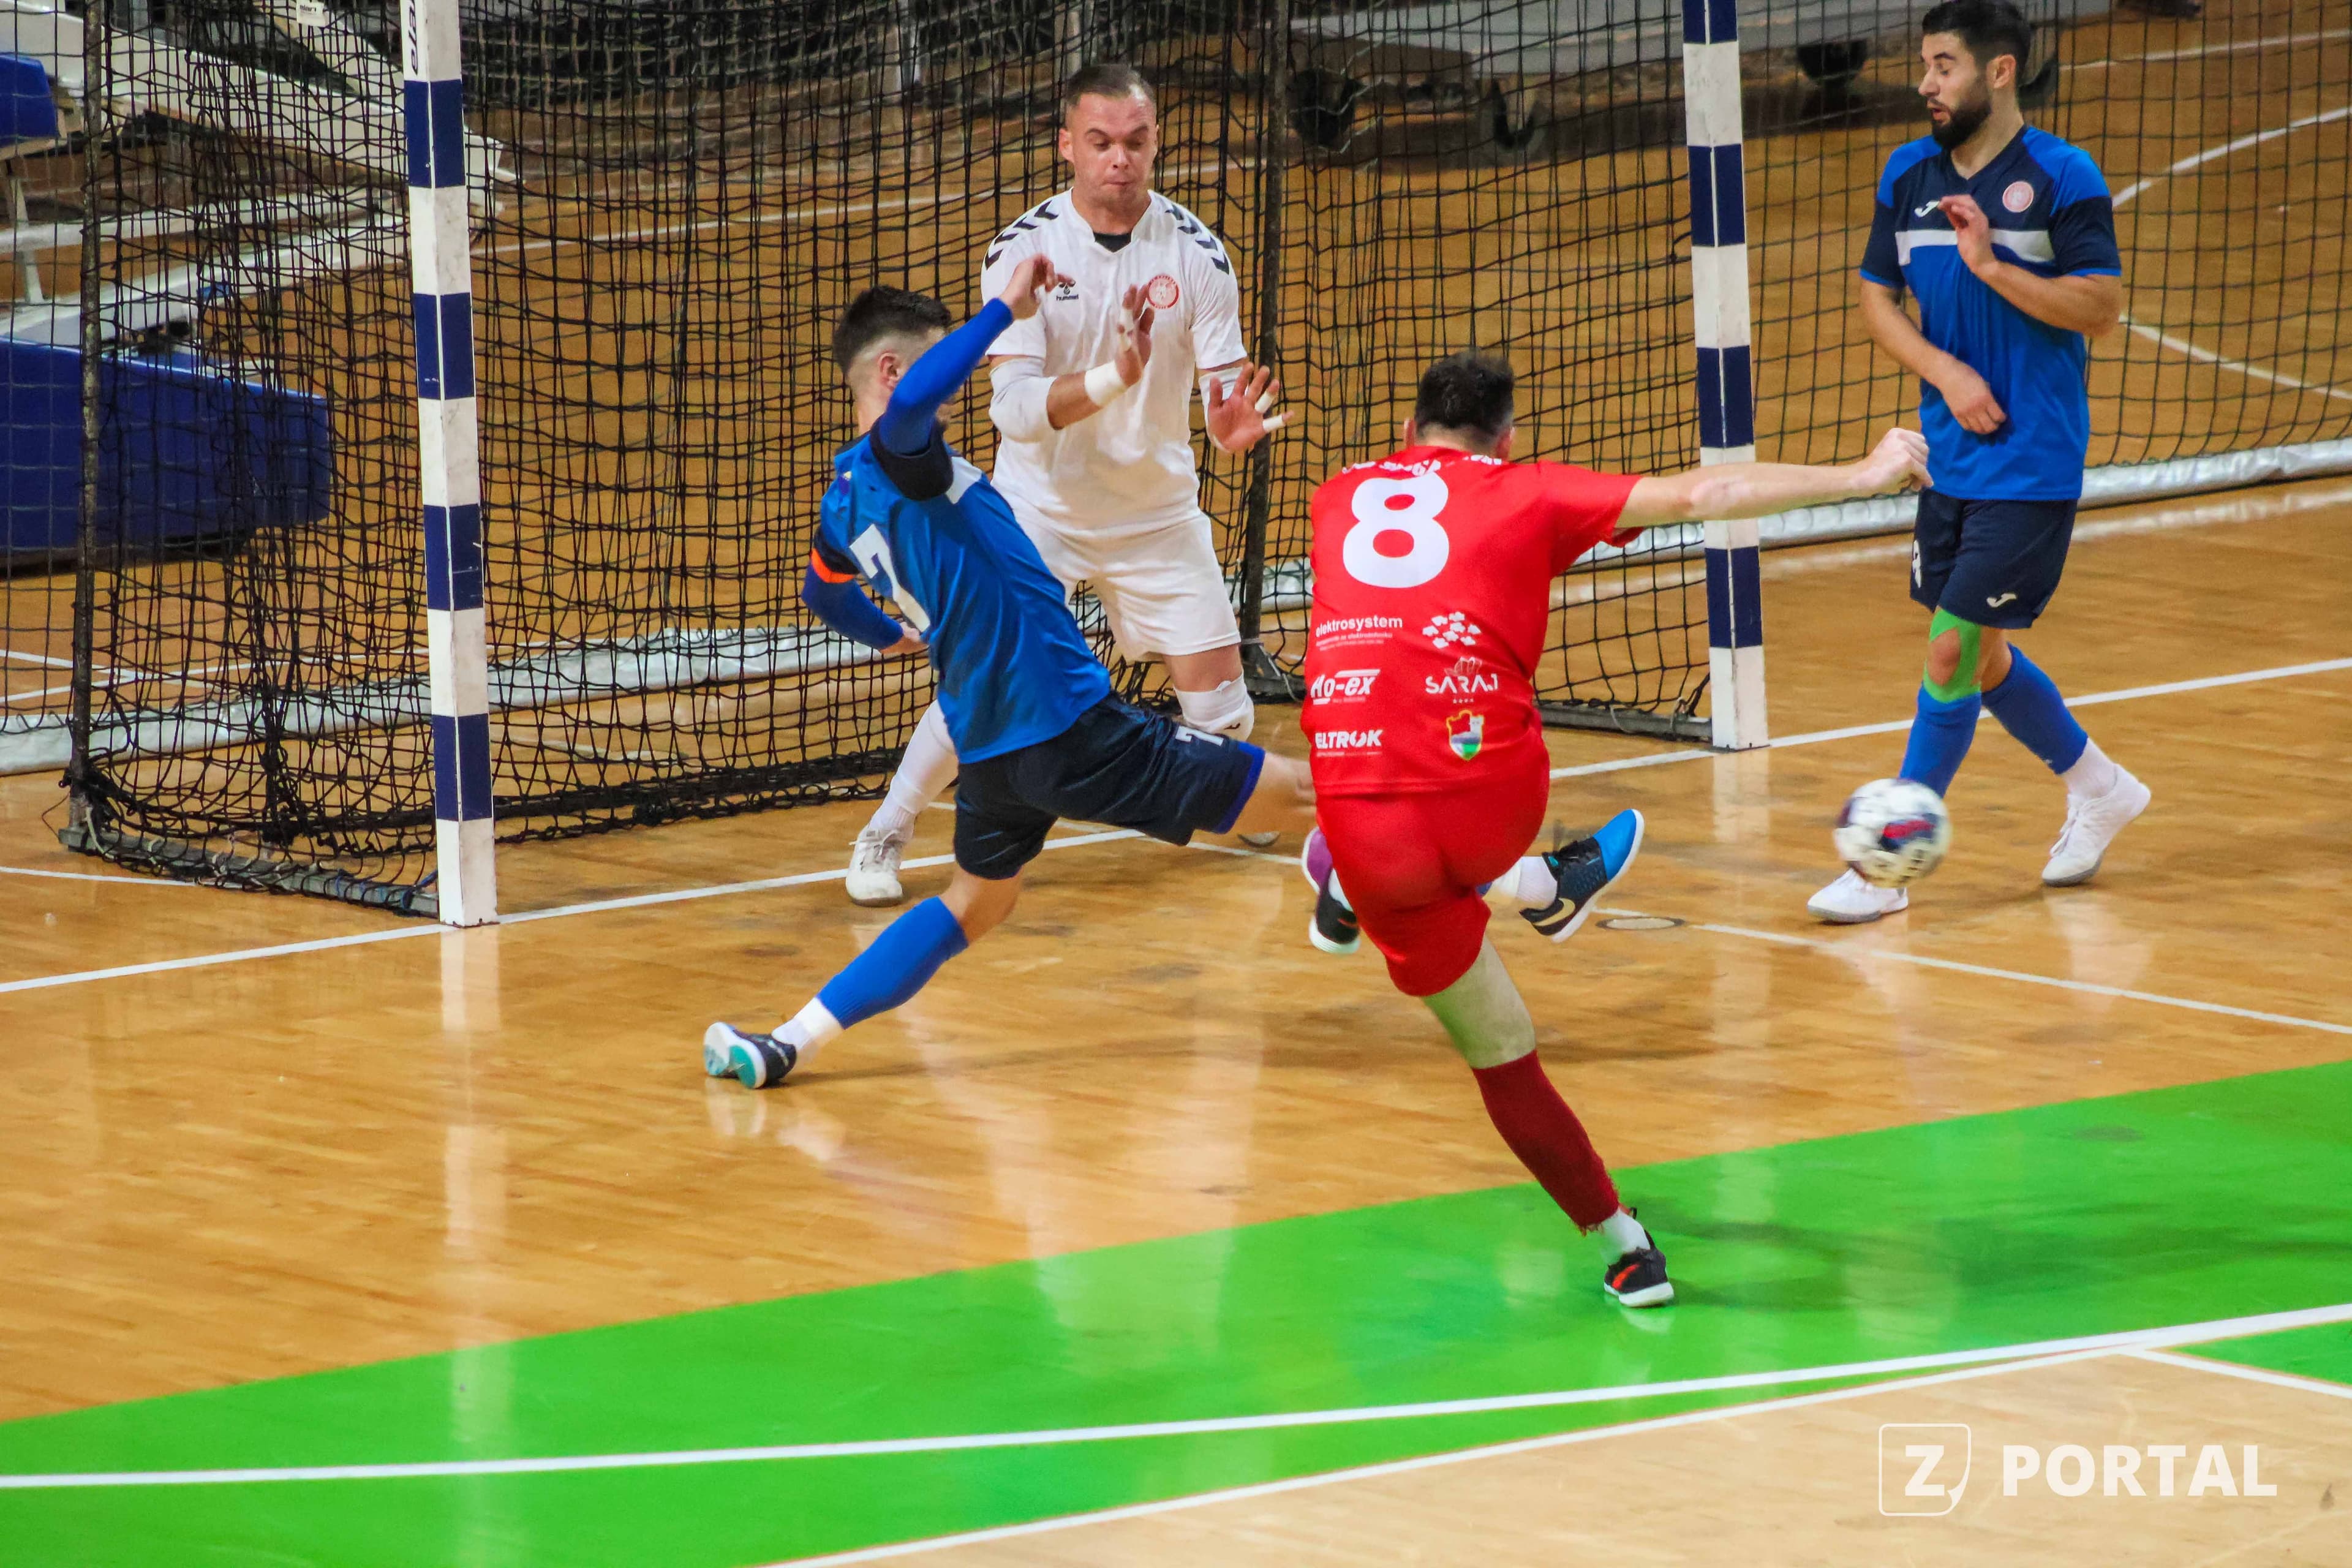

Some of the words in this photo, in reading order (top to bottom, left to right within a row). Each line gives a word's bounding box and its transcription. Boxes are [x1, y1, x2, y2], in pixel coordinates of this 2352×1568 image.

[1343, 472, 1449, 588] 8
[849, 524, 931, 633] 7
[1316, 615, 1403, 638] elektrosystem
[1425, 673, 1499, 694] SARAJ
